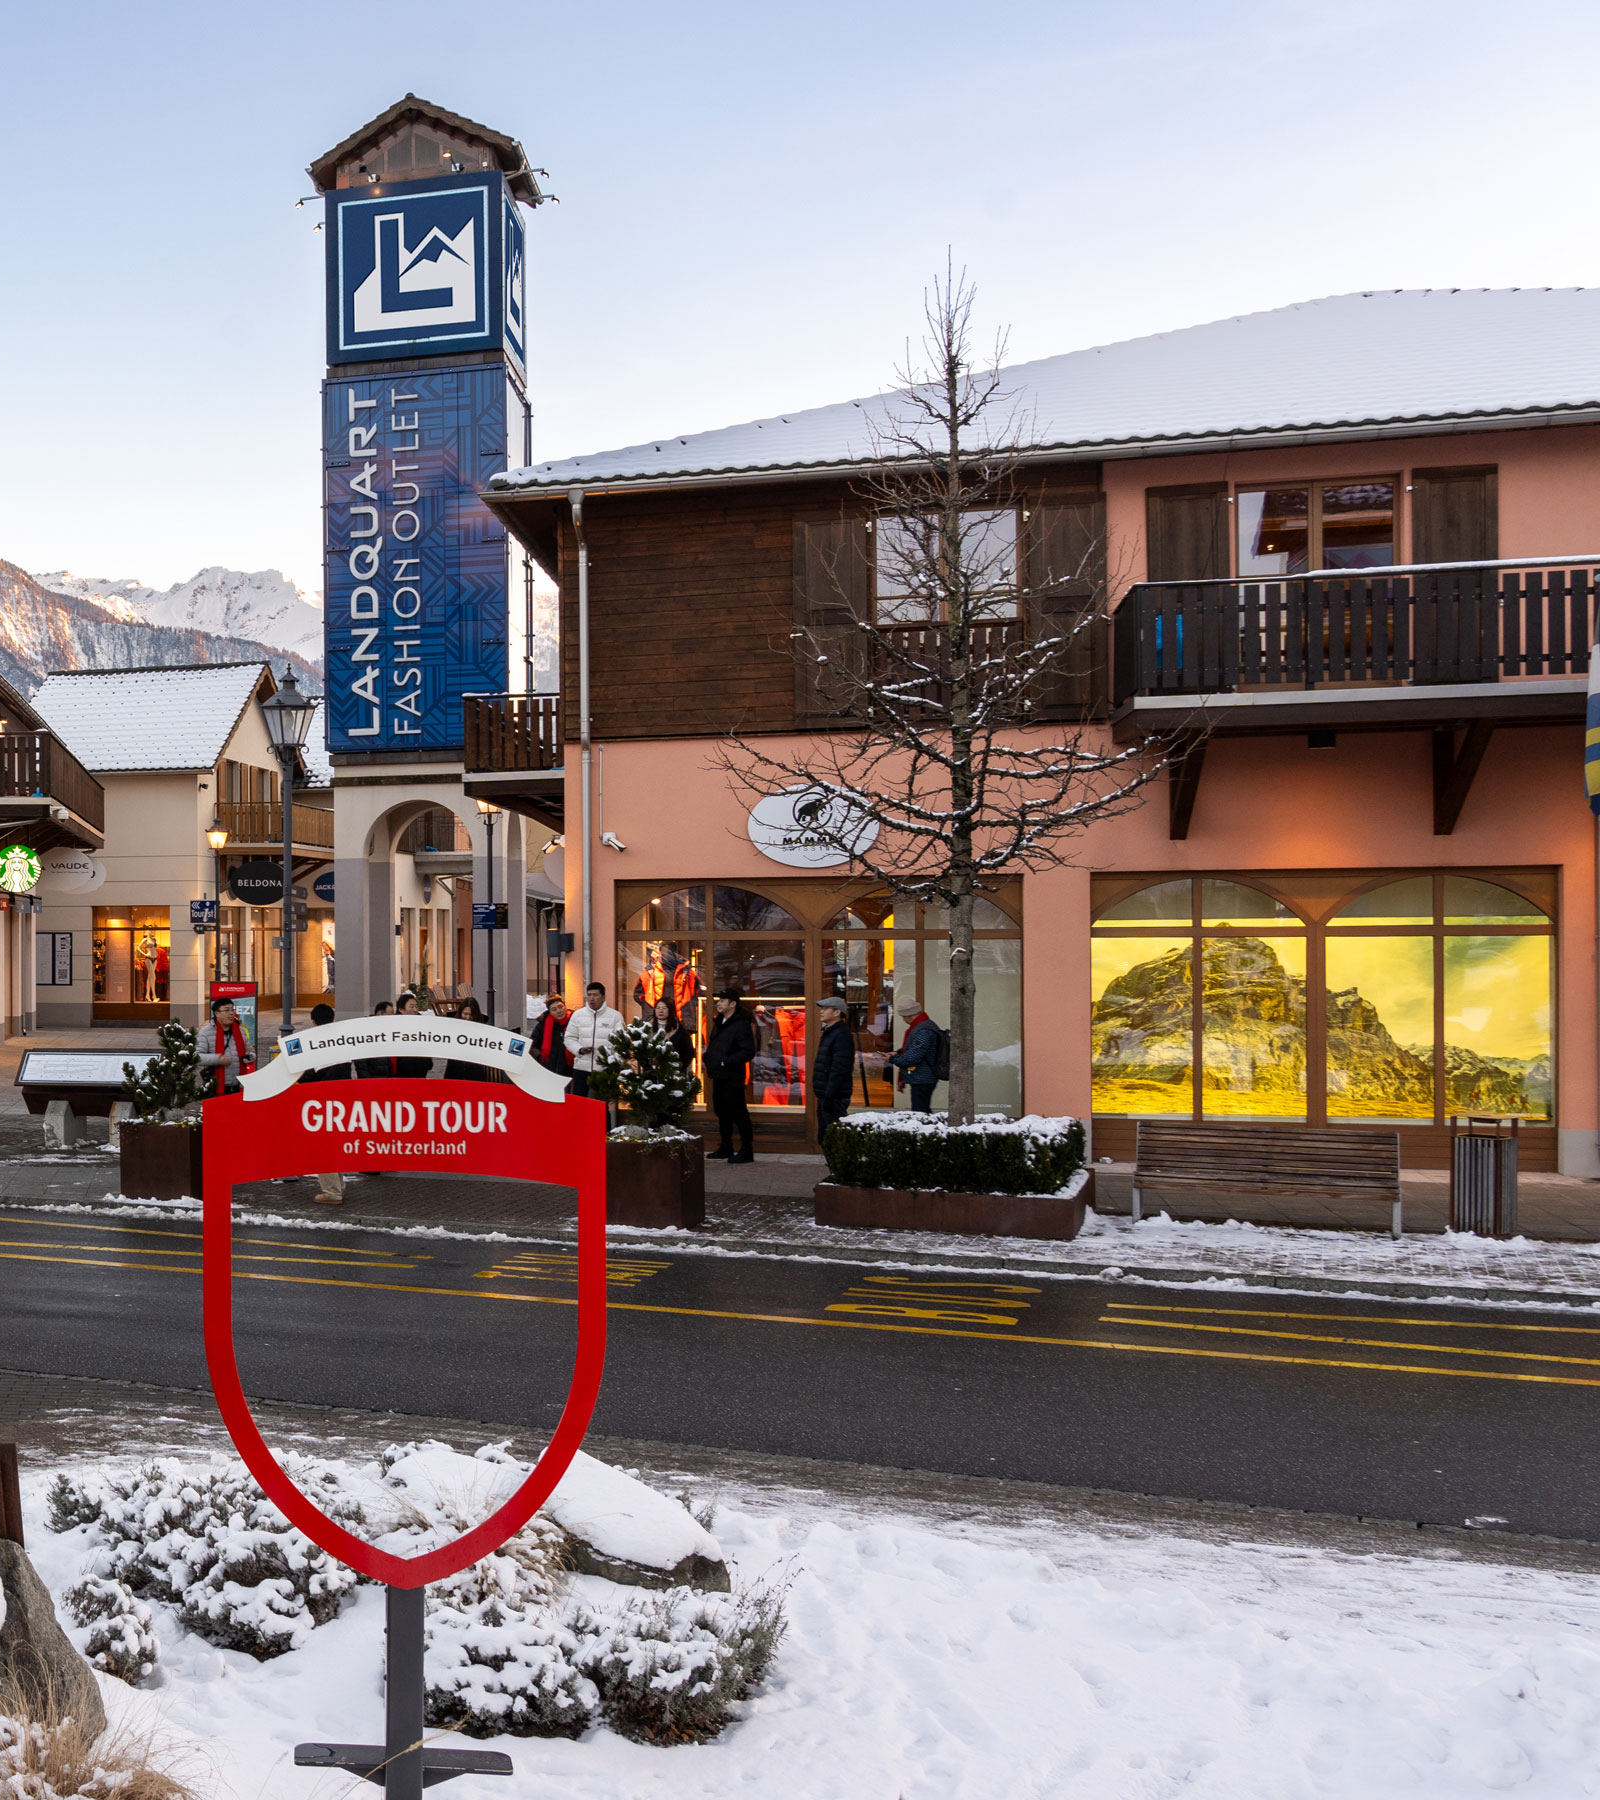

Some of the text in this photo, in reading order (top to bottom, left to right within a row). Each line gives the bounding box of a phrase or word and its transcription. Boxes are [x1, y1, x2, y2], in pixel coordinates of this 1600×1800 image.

[348, 388, 382, 736] LANDQUART
[391, 388, 421, 734] FASHION OUTLET
[51, 862, 89, 870] VAUDE
[237, 879, 283, 887] BELDONA
[309, 1031, 504, 1051] Landquart Fashion Outlet
[301, 1100, 508, 1133] GRAND TOUR
[343, 1139, 467, 1155] of Switzerland
[824, 1276, 1043, 1325] BUS
